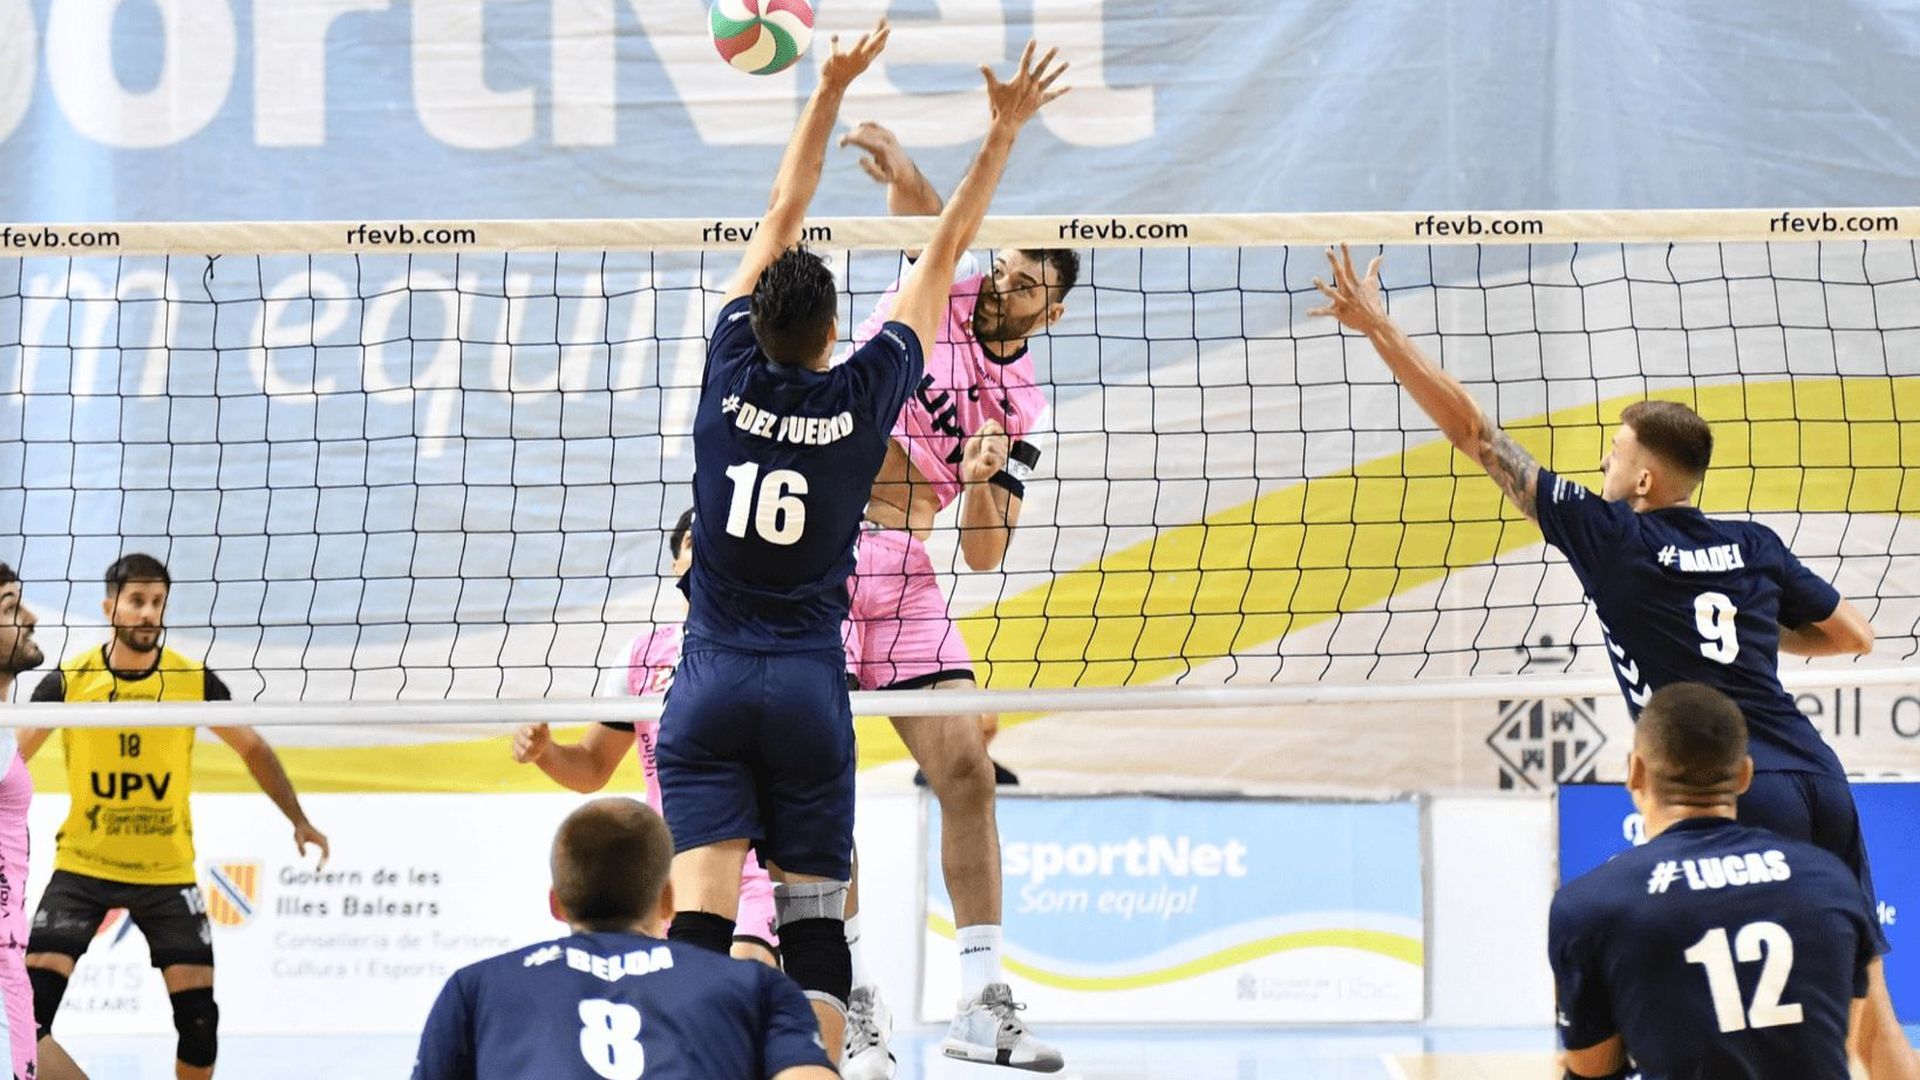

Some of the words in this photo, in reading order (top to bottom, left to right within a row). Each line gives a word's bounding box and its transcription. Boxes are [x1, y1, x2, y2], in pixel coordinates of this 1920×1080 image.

[0, 0, 1155, 149] ortNet
[0, 227, 120, 248] fevb.com
[346, 224, 476, 246] rfevb.com
[703, 221, 832, 242] rfevm
[1059, 218, 1189, 240] rfevb.com
[1415, 215, 1544, 236] rfevb.com
[1769, 212, 1899, 234] rfevb.com
[725, 461, 809, 546] 16
[1694, 591, 1738, 664] 9
[118, 732, 141, 757] 18
[90, 771, 171, 800] UPV
[1000, 833, 1248, 885] sportNet
[1647, 850, 1792, 894] #LUCAS
[279, 866, 363, 886] Govern
[372, 867, 400, 885] de
[409, 867, 442, 885] les
[276, 896, 328, 915] Illes
[343, 896, 441, 916] Balears
[1017, 883, 1088, 913] Som
[1097, 883, 1198, 921] equip!
[523, 945, 674, 982] #BELDA
[1684, 921, 1804, 1033] 12
[578, 998, 645, 1080] 8
